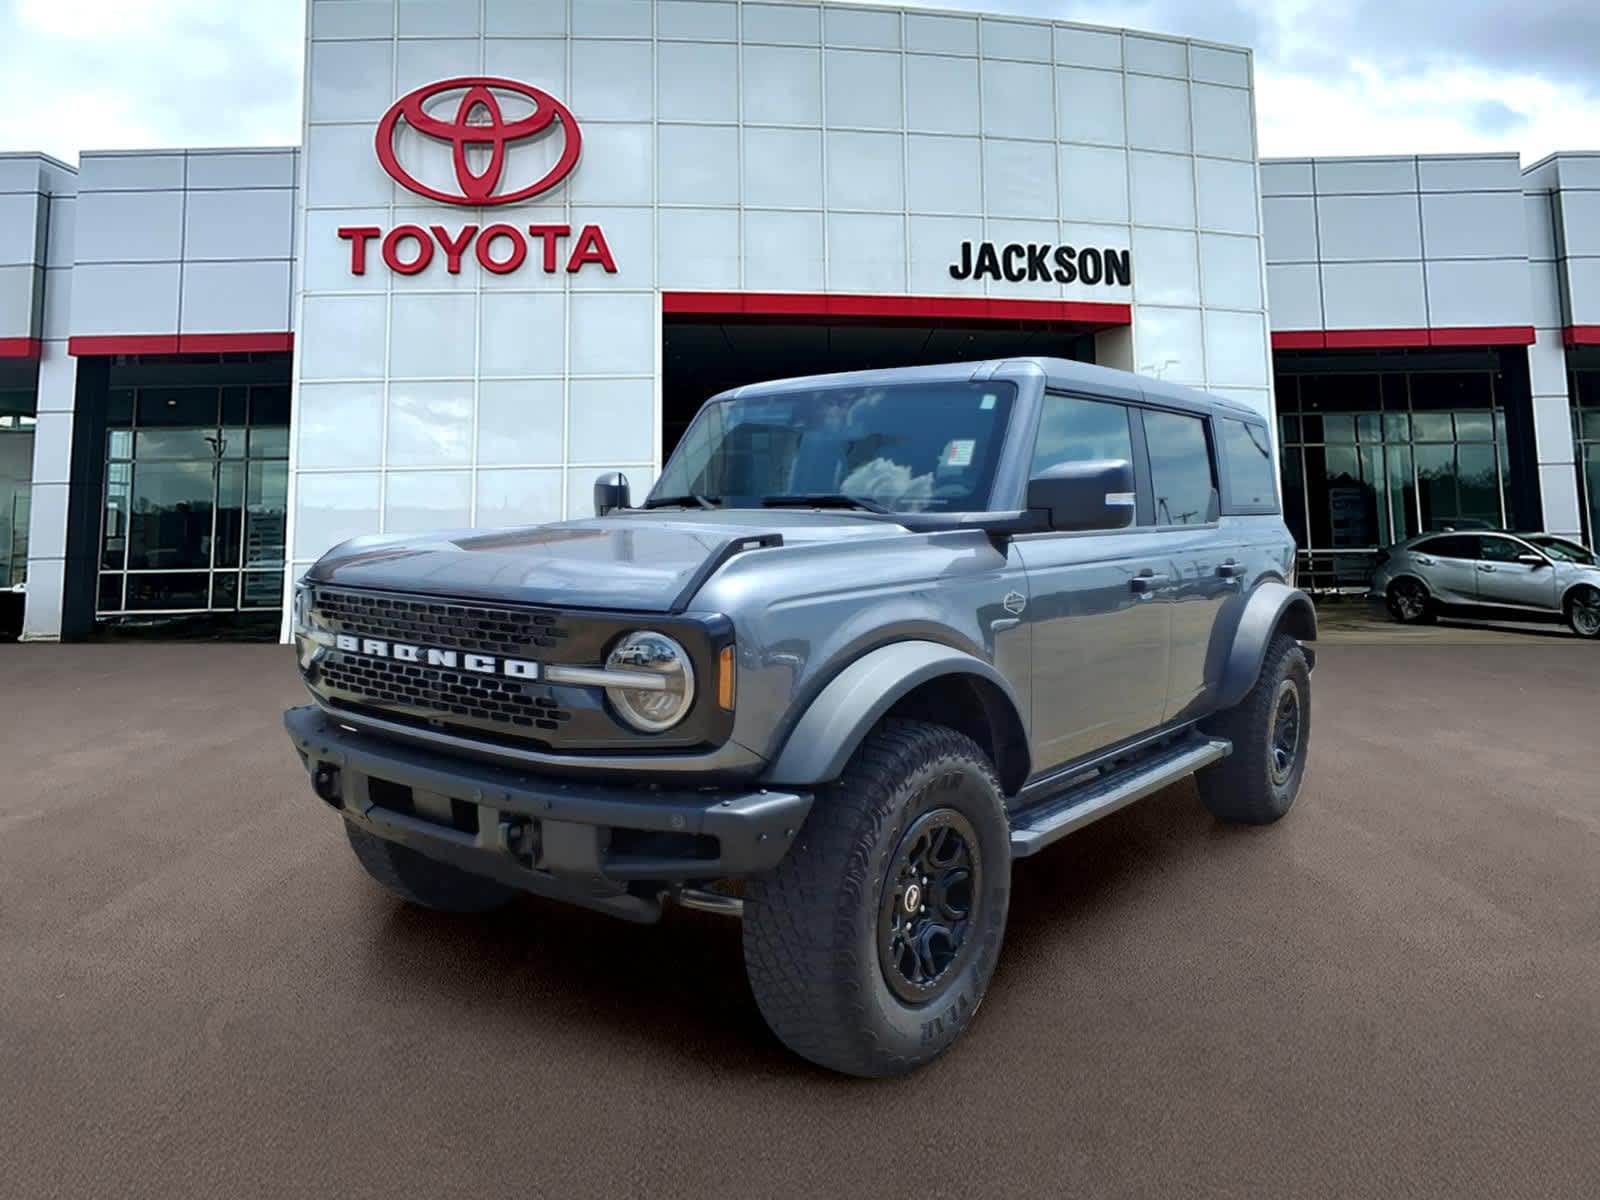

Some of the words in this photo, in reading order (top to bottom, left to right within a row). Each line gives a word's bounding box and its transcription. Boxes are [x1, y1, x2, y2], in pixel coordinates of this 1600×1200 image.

[337, 223, 618, 275] TOYOTA
[949, 241, 1132, 286] JACKSON
[336, 633, 539, 680] BRONCO
